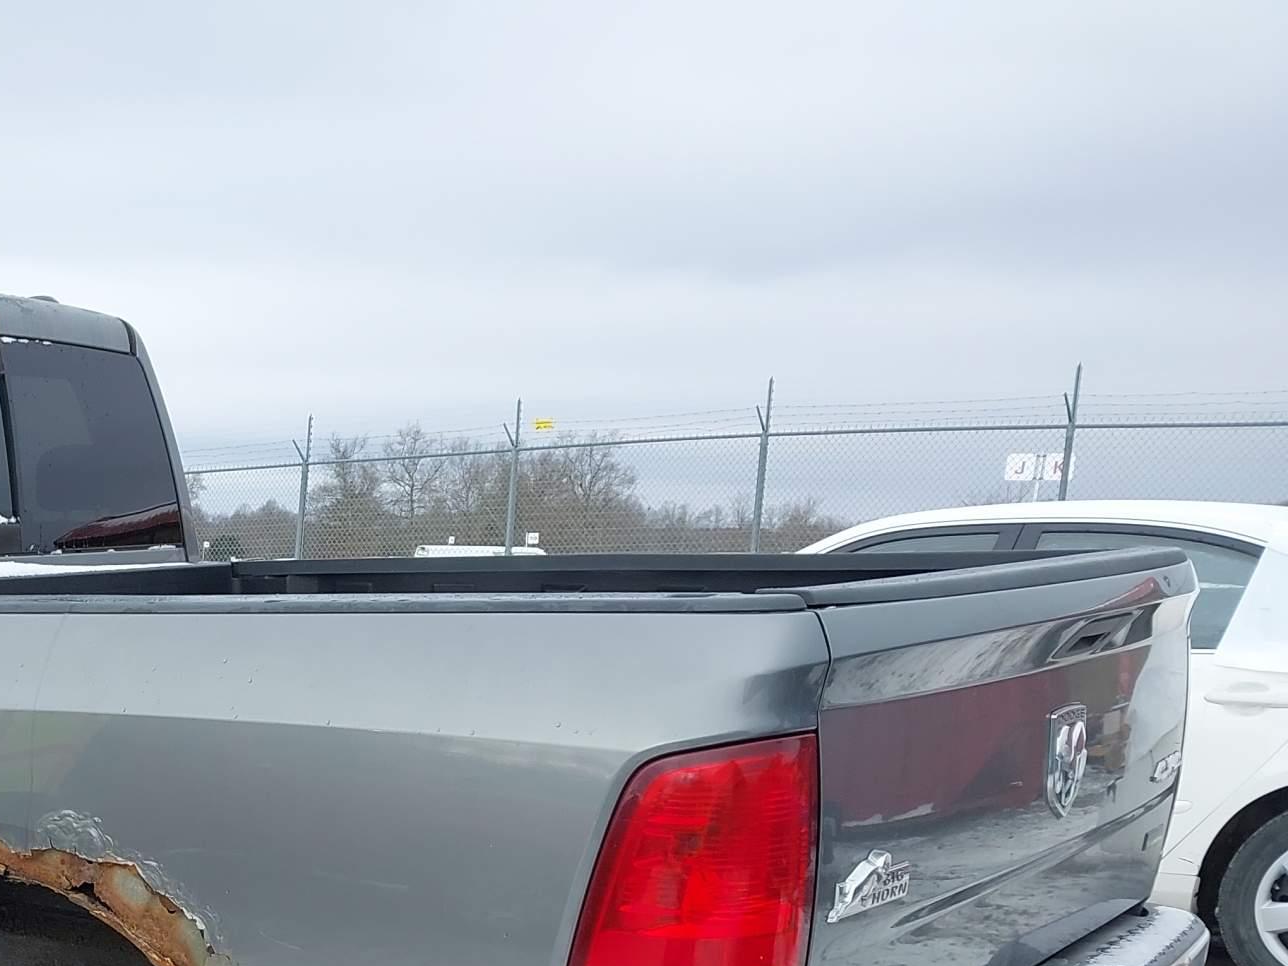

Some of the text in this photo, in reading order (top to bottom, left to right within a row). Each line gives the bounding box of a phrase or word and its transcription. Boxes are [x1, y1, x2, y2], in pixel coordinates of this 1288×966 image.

[1014, 461, 1026, 475] J
[883, 869, 905, 886] BIG
[872, 881, 908, 905] HORN
